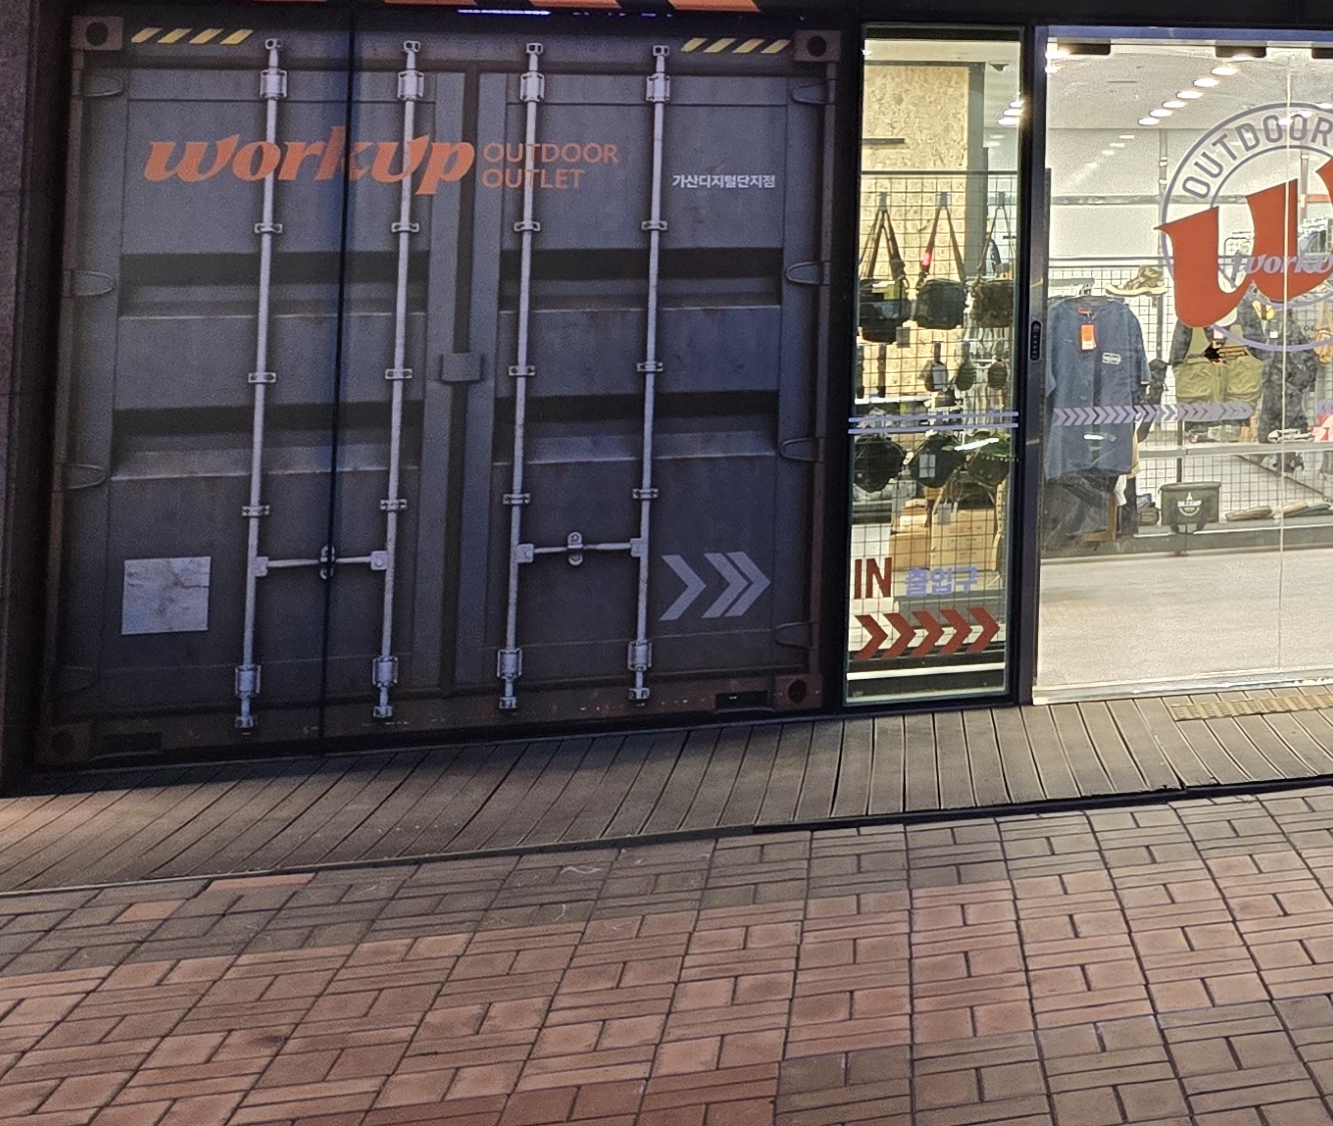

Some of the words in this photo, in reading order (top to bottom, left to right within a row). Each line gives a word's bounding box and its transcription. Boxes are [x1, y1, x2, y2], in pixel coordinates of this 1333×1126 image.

[144, 126, 475, 195] workup
[482, 142, 619, 164] OUTDOOR
[1182, 114, 1333, 199] OUTDOOR
[481, 168, 585, 189] OUTLET
[672, 174, 776, 189] 가산디지털단지점
[854, 557, 892, 599] IN
[904, 565, 979, 597] 출입구
